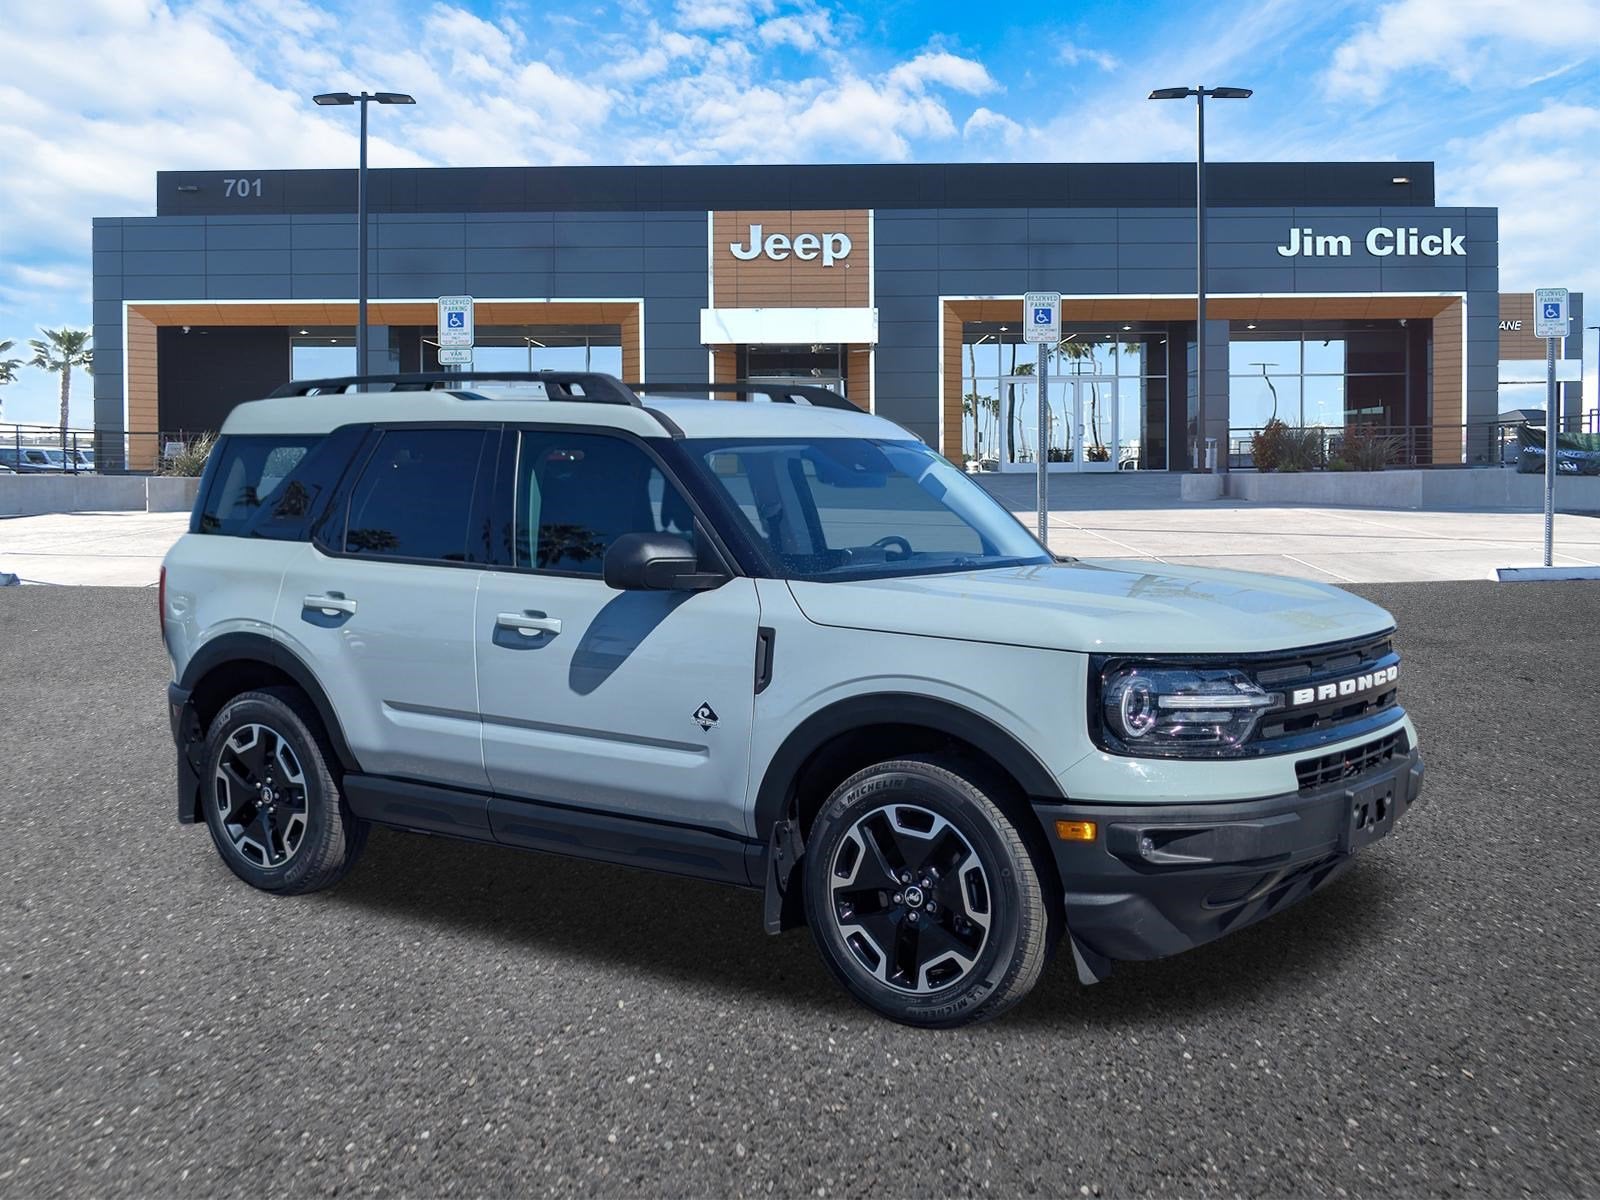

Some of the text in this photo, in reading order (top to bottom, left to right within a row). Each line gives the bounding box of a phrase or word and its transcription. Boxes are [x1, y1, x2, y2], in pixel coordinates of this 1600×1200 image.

[223, 178, 262, 197] 701
[730, 224, 852, 267] Jeep
[1277, 227, 1467, 257] Jim Click
[1498, 320, 1522, 331] ANE
[1293, 665, 1398, 706] BRONCO
[846, 779, 904, 804] MICHELIN
